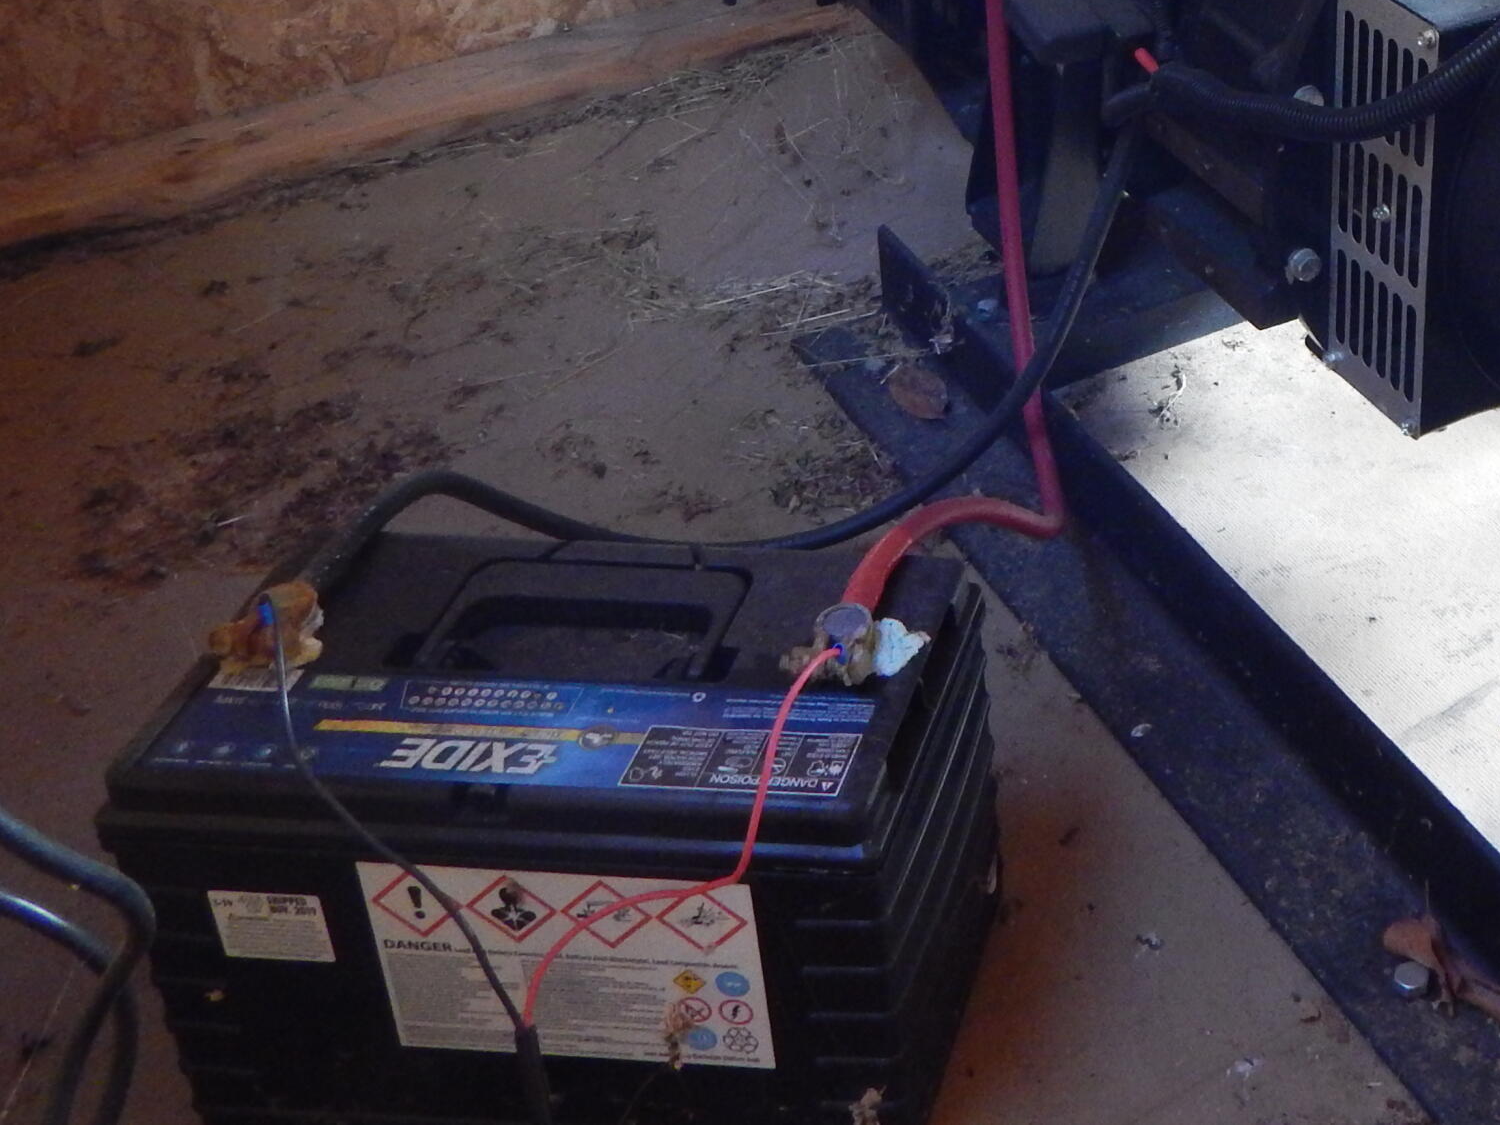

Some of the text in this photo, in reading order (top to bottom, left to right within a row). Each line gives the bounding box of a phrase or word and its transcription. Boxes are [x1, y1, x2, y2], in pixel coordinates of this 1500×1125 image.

[379, 737, 559, 775] EXIDE
[709, 774, 761, 786] POISON
[383, 939, 452, 952] DANGER
